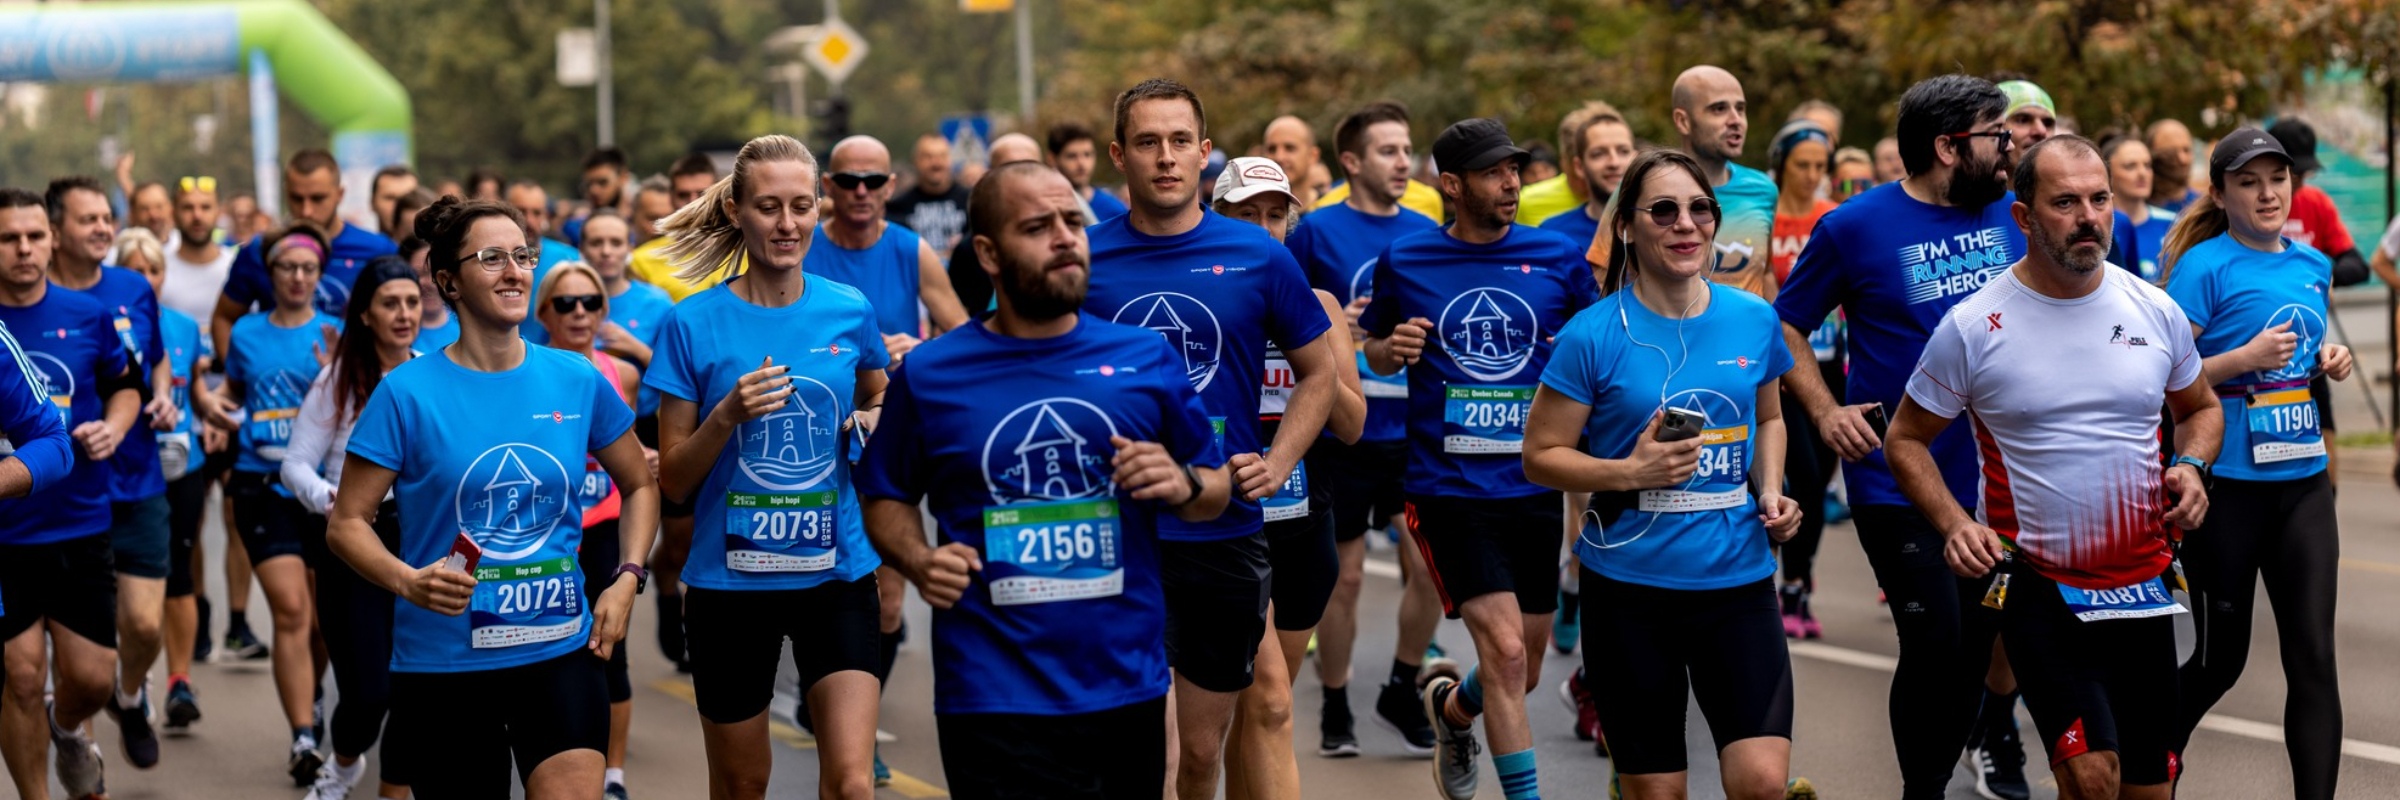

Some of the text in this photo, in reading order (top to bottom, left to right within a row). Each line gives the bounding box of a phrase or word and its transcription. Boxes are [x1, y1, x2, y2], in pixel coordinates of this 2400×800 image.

[1919, 229, 1995, 261] I'M THE
[1912, 245, 2007, 284] RUNNING
[1937, 268, 1991, 297] HERO
[1493, 390, 1514, 398] Canada
[1464, 402, 1521, 428] 2034
[2271, 403, 2314, 433] 1190
[270, 419, 293, 441] 10
[1691, 446, 1731, 477] 34
[733, 495, 745, 506] 21
[770, 495, 784, 507] hipi
[785, 495, 800, 507] hopi
[752, 510, 819, 540] 2073
[1017, 523, 1095, 564] 2156
[477, 568, 489, 580] 21
[515, 566, 528, 577] Hop
[529, 565, 543, 575] cup
[498, 577, 562, 614] 2072
[2083, 583, 2147, 606] 2087
